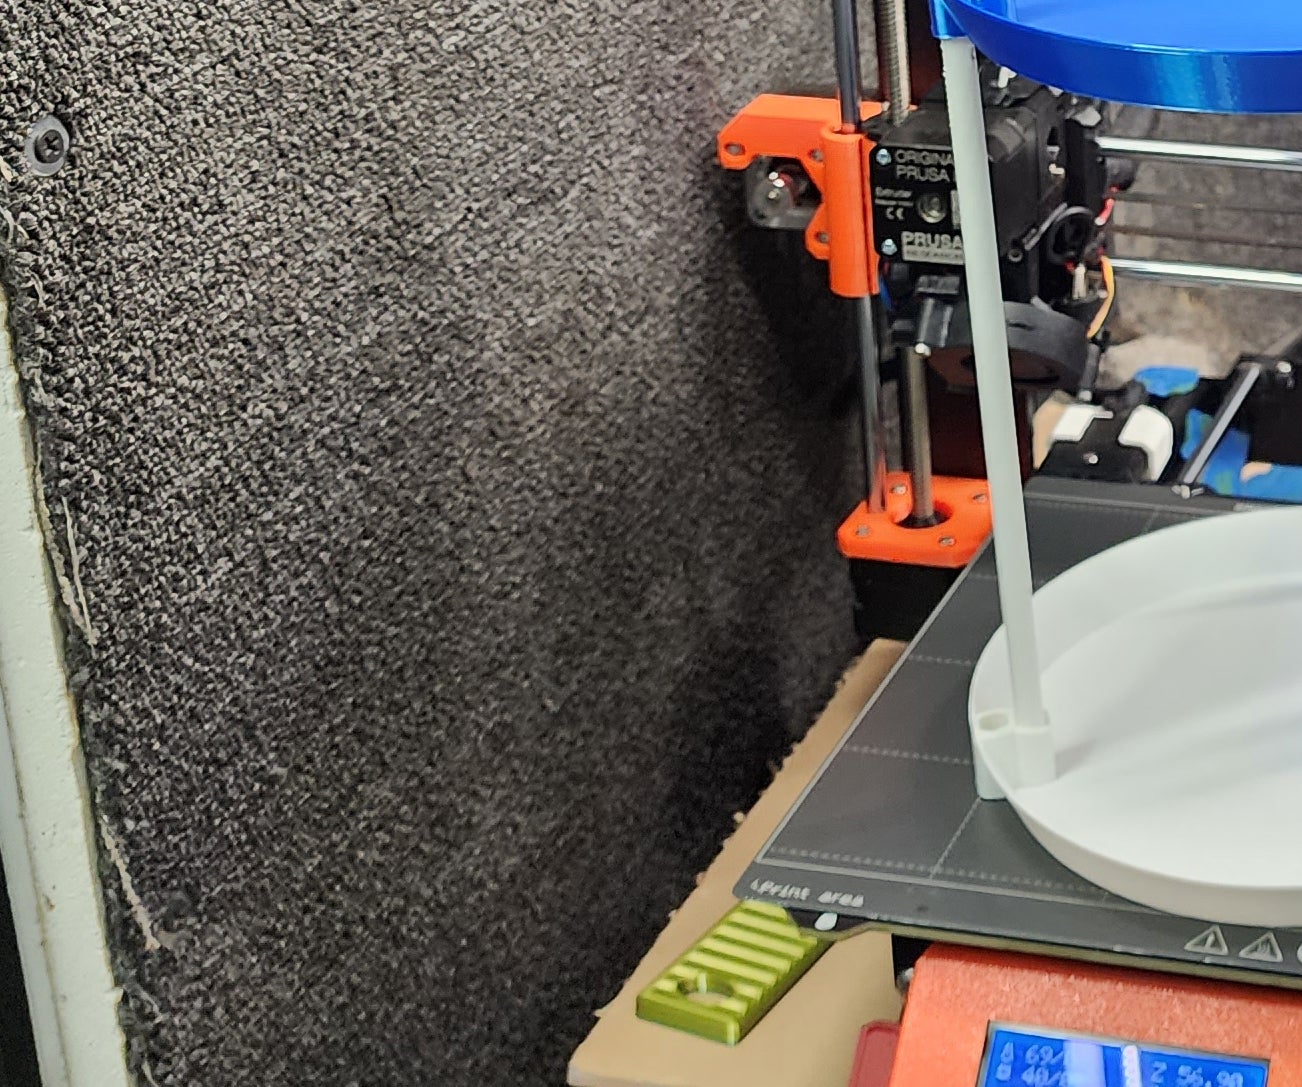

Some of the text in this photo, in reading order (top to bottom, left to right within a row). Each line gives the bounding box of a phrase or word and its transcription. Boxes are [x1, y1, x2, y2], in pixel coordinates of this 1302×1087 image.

[895, 149, 954, 166] ORIGINA
[896, 165, 951, 182] PRUSA
[901, 232, 962, 249] PRUSA
